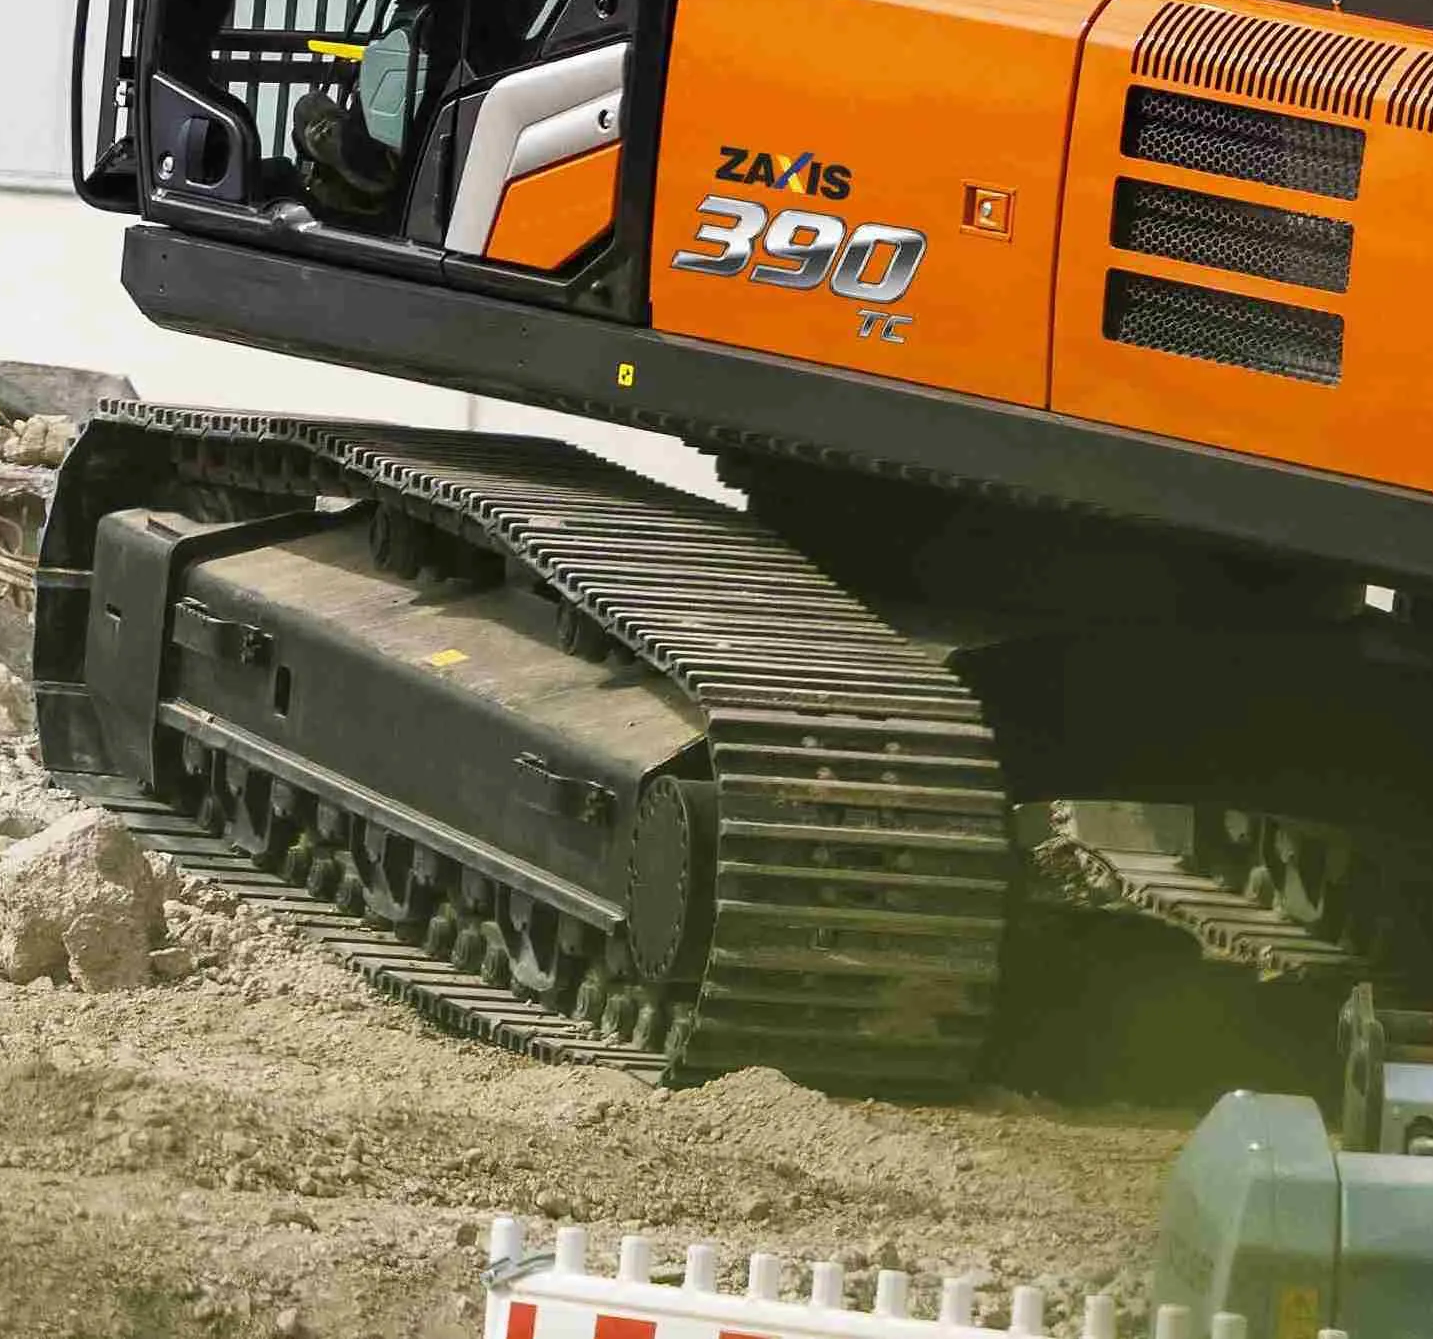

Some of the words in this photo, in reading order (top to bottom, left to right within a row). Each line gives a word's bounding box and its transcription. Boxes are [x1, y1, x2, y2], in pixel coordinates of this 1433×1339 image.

[714, 145, 853, 200] ZAXIS
[672, 193, 928, 304] 390
[856, 307, 914, 344] TC
